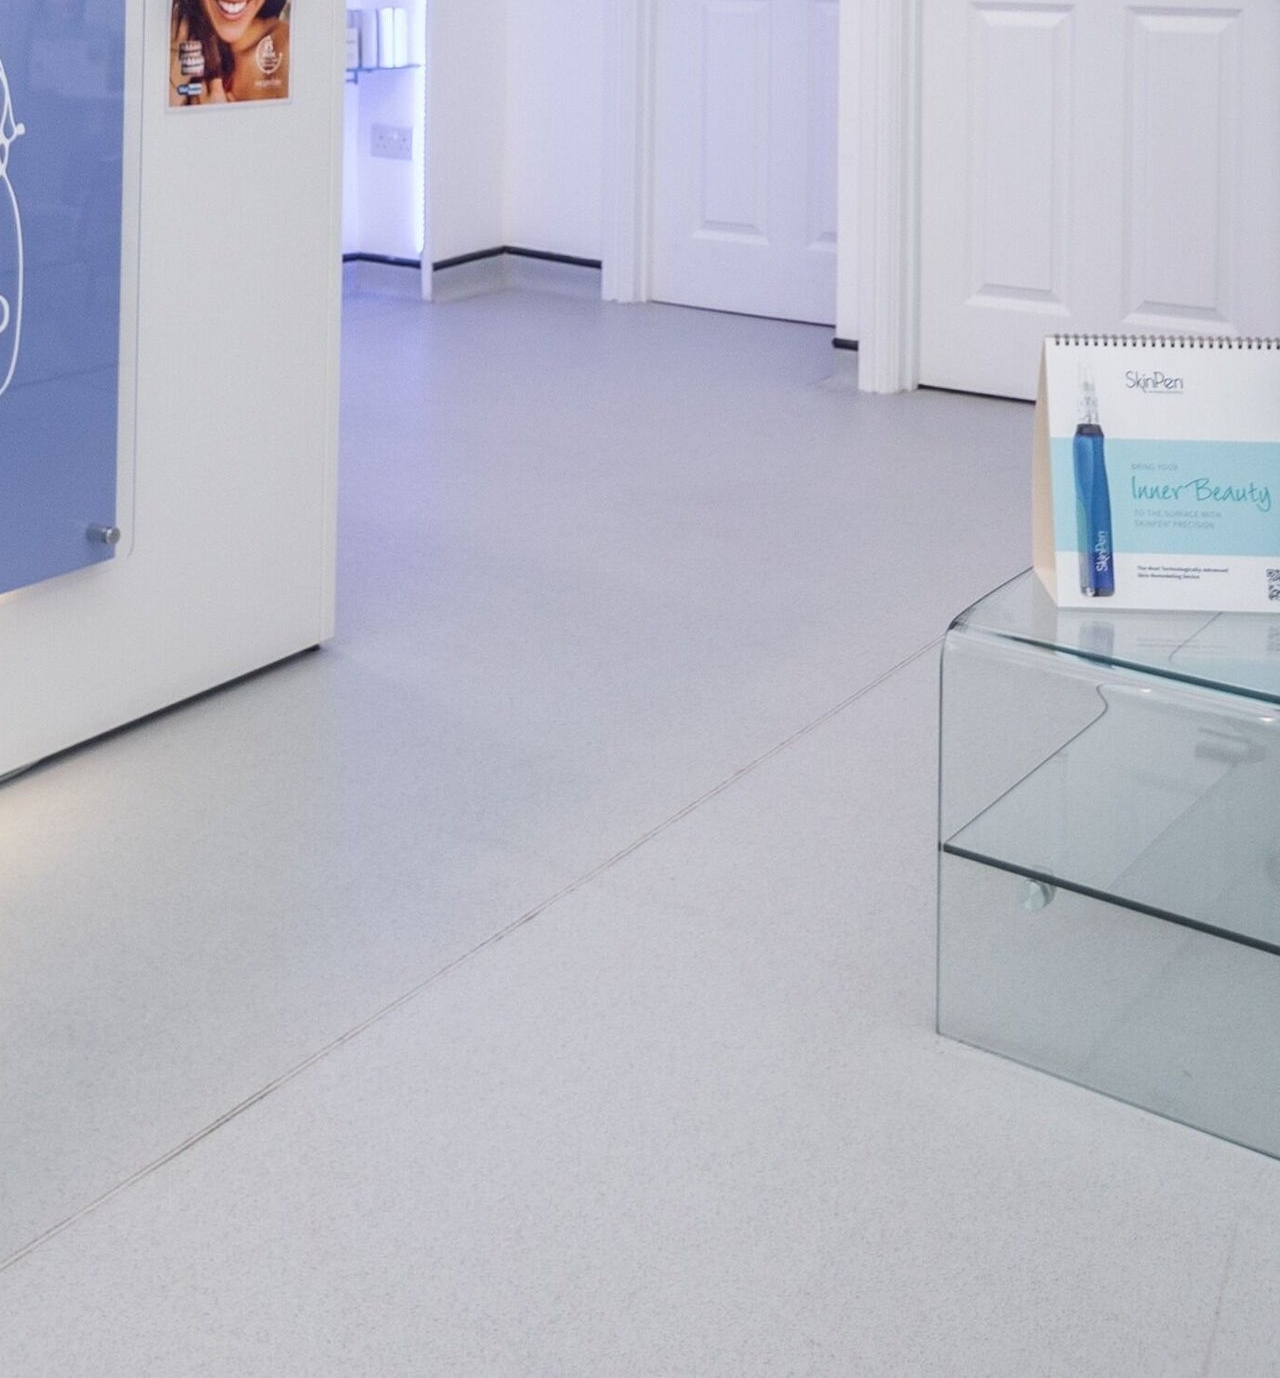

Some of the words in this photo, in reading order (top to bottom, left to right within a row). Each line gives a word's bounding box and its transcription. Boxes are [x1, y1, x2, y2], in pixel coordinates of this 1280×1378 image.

[1125, 369, 1184, 394] SkinPen
[1130, 475, 1183, 500] Inner
[1186, 477, 1272, 513] Beauty
[1094, 530, 1111, 572] SkinPen
